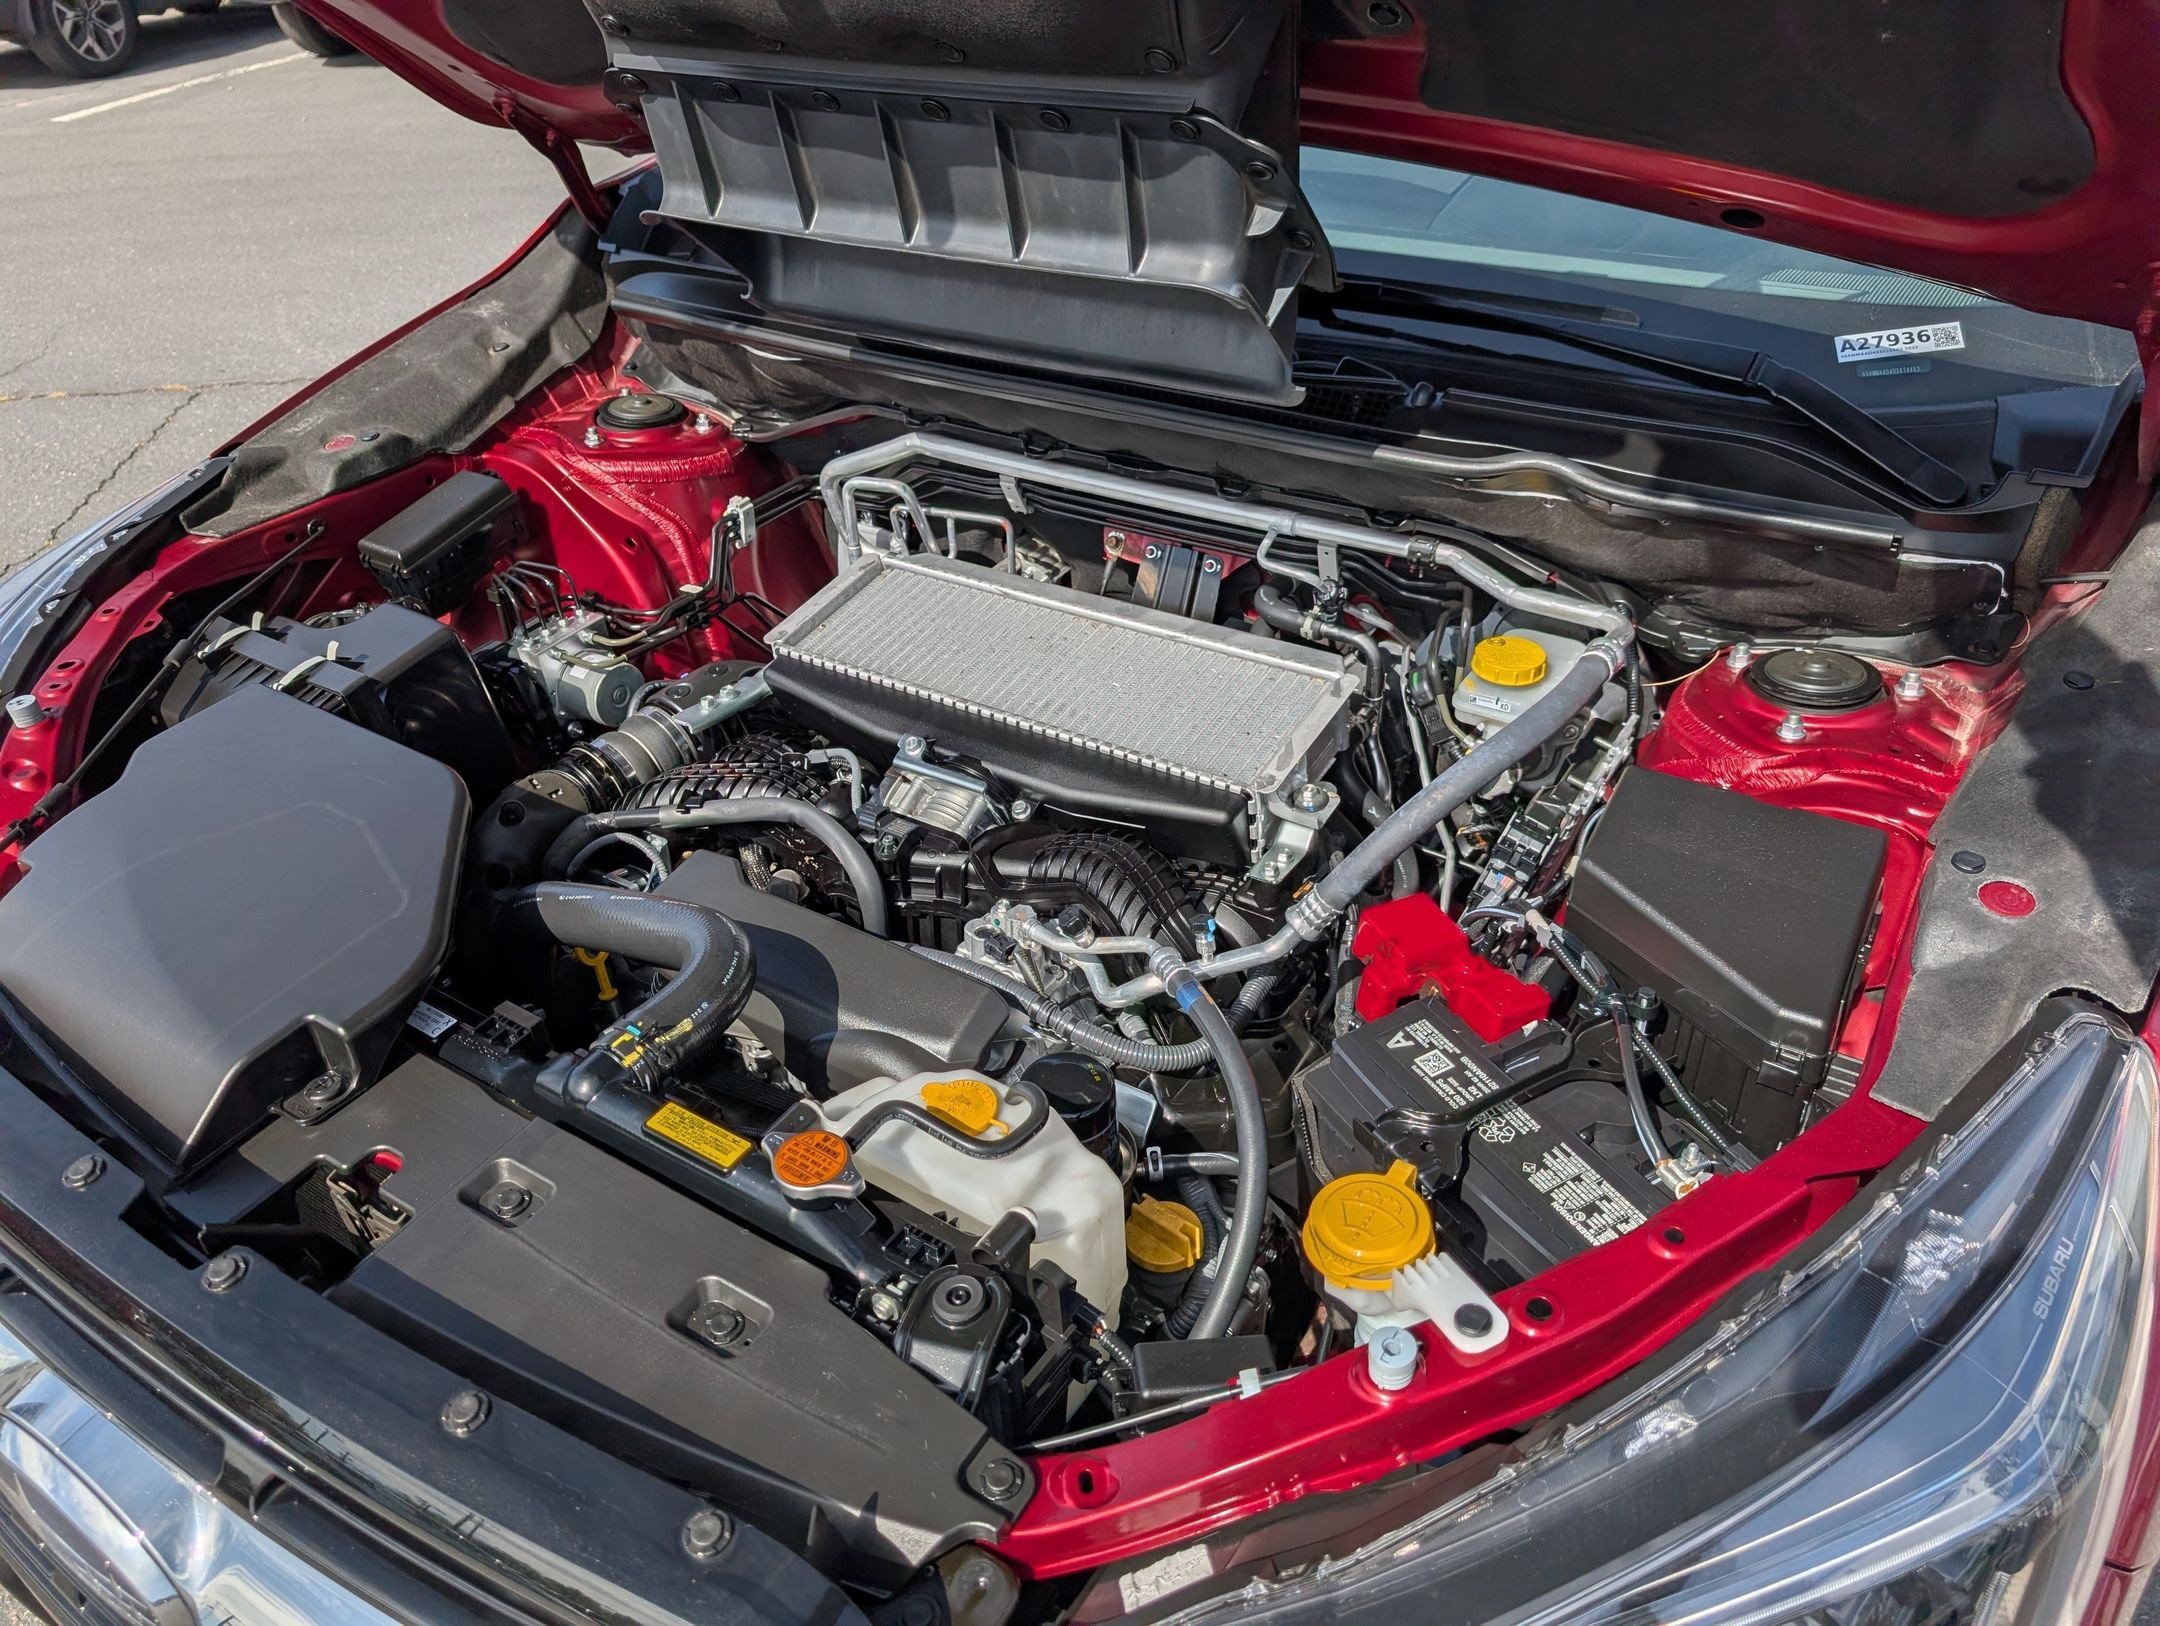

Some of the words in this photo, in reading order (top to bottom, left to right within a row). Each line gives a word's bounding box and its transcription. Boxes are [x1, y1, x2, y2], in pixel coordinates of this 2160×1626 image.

[1840, 329, 1931, 353] A27936
[1385, 1029, 1415, 1050] A
[1410, 1063, 1425, 1078] AMPS
[1459, 1054, 1500, 1090] 82110AN00B
[1463, 1069, 1473, 1077] AH
[1422, 1075, 1447, 1098] CRANKING
[1435, 1077, 1456, 1096] AMPS
[1446, 1076, 1459, 1087] SIZE
[1476, 1080, 1491, 1093] 20HR
[1452, 1093, 1467, 1106] 620
[1456, 1085, 1475, 1101] GROUP
[1467, 1085, 1483, 1098] LN2
[1443, 1095, 1459, 1110] COLD
[1506, 1110, 1524, 1127] RECYCLE
[1508, 1118, 1527, 1135] BATTERY
[1490, 1125, 1500, 1135] Pb
[813, 1140, 841, 1160] WARNING
[1550, 1200, 1600, 1248] ANGER/POISON
[2030, 1235, 2075, 1321] SUBARU
